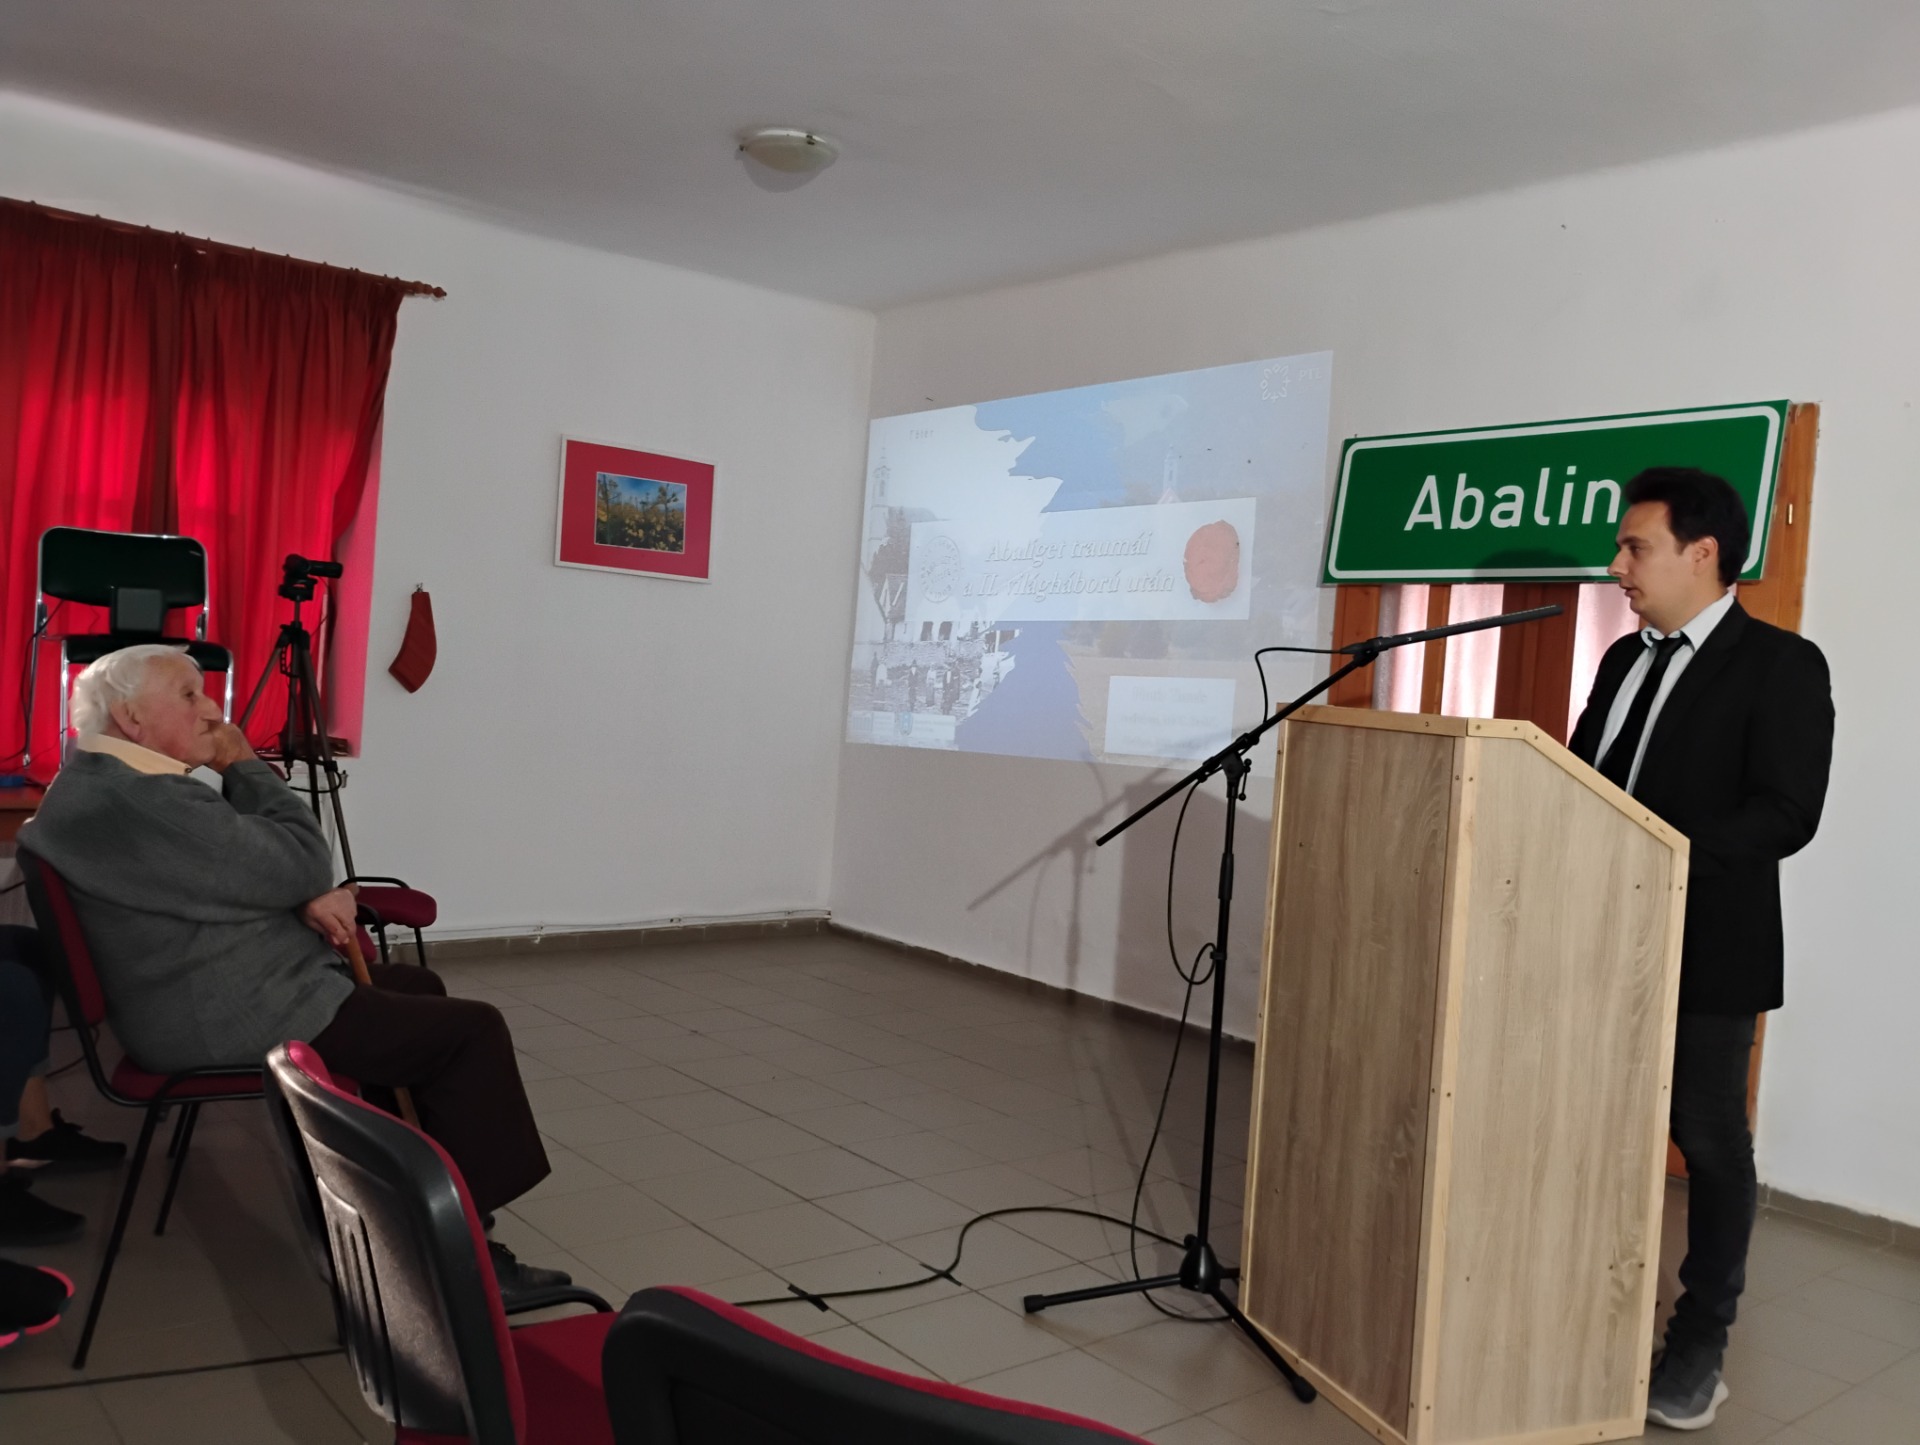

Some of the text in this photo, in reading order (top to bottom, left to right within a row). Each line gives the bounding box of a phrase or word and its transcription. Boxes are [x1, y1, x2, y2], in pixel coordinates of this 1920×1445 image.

[1404, 465, 1622, 531] Abalin
[1070, 531, 1154, 559] traumái
[962, 583, 973, 597] a
[1005, 569, 1122, 603] világháború
[1126, 568, 1175, 593] után
